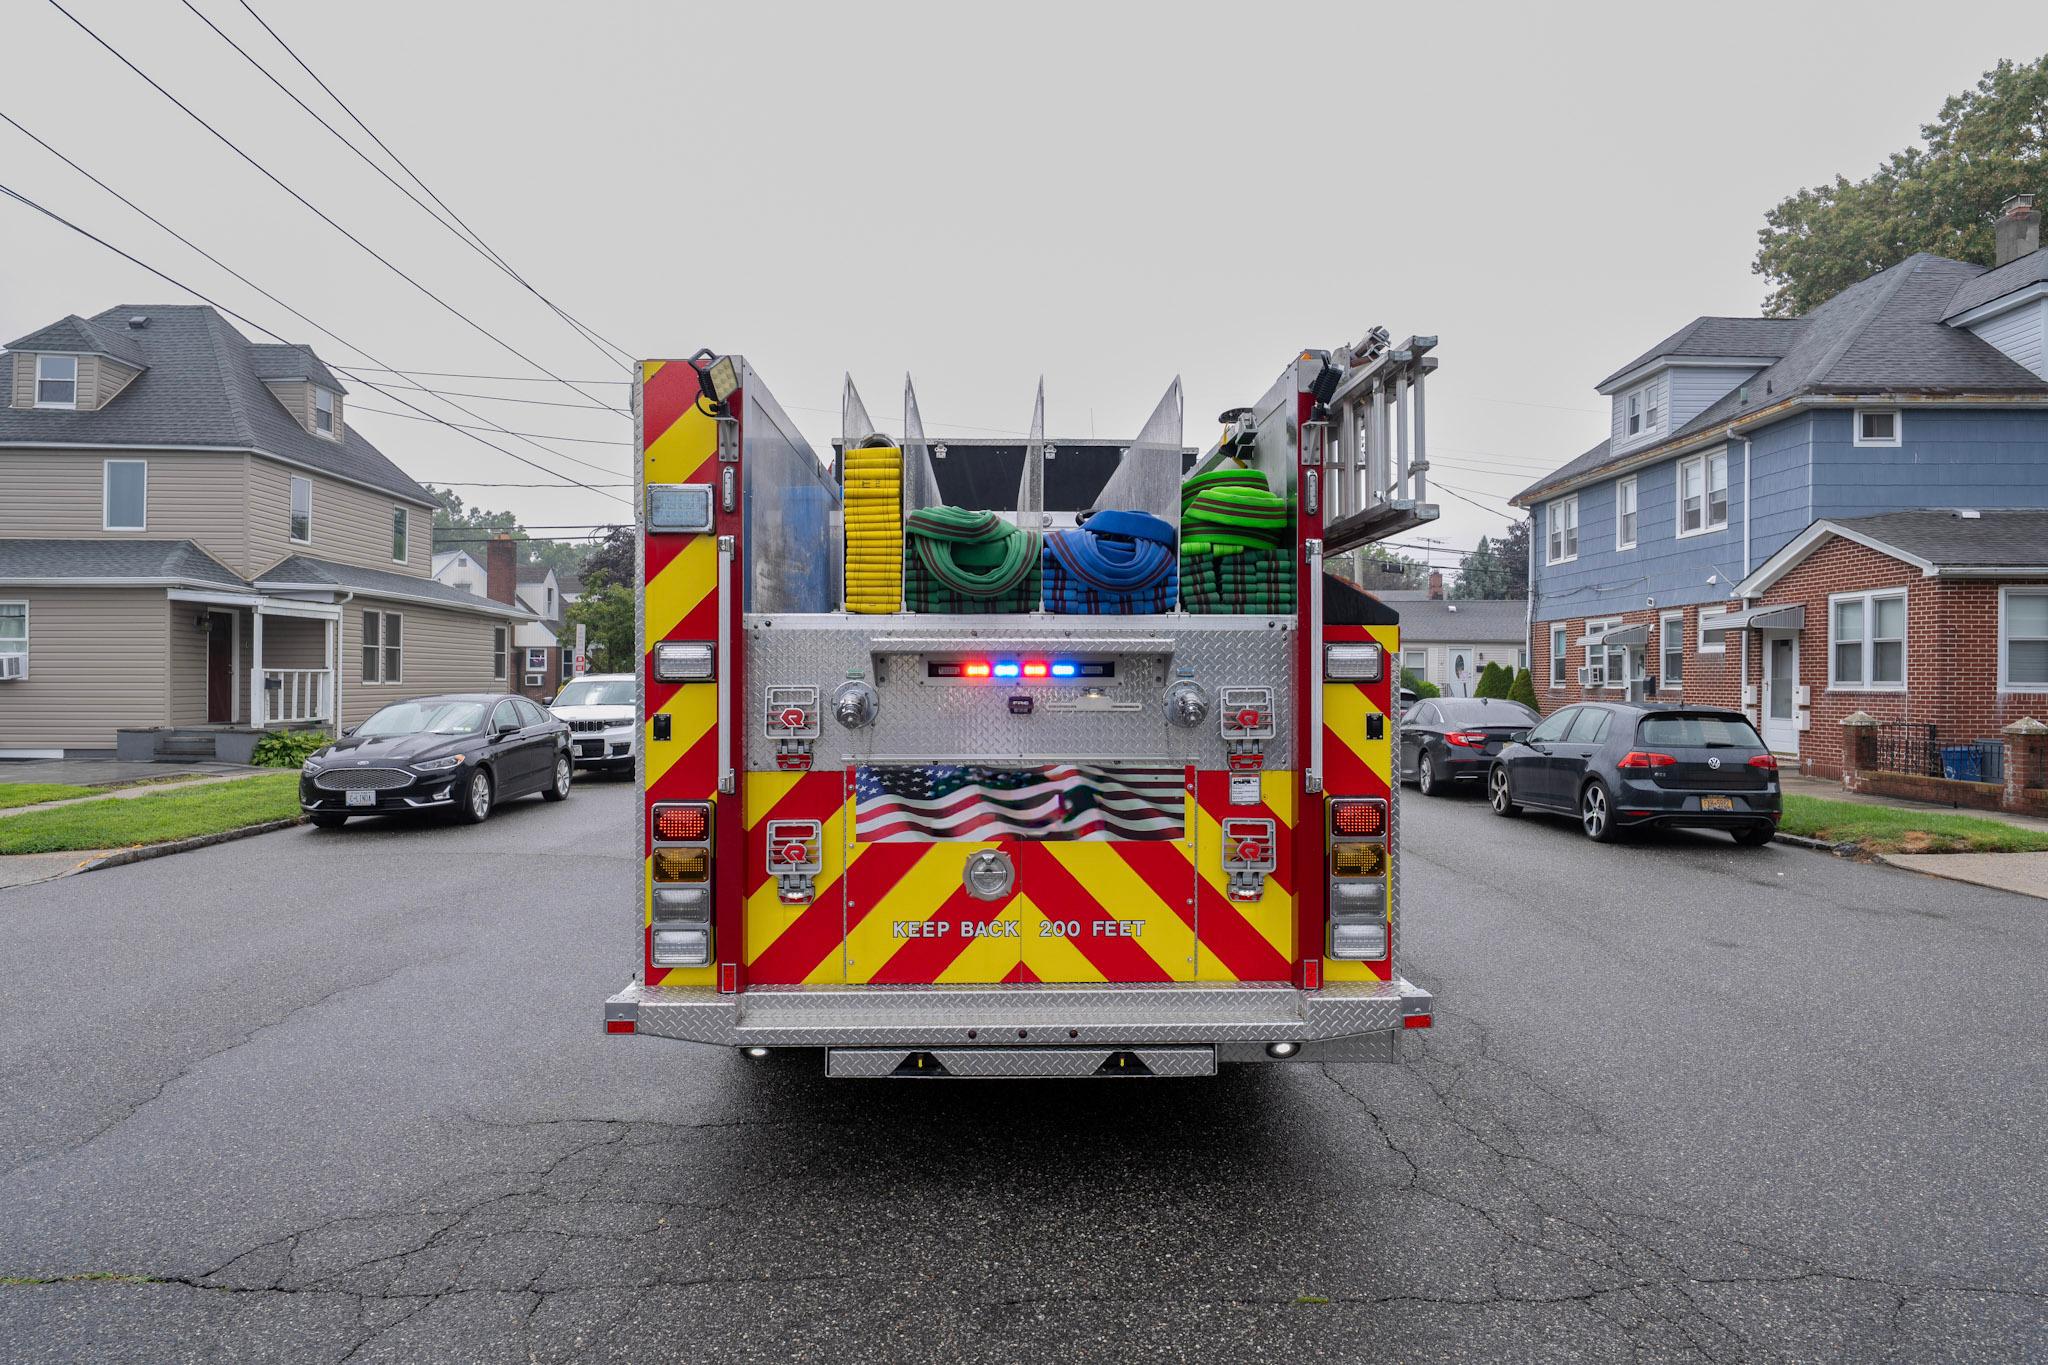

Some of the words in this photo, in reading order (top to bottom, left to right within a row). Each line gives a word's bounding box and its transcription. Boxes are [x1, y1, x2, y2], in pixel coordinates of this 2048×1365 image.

[892, 921, 950, 938] KEEP
[960, 920, 1020, 938] BACK
[1039, 920, 1081, 938] 200
[1092, 920, 1145, 937] FEET
